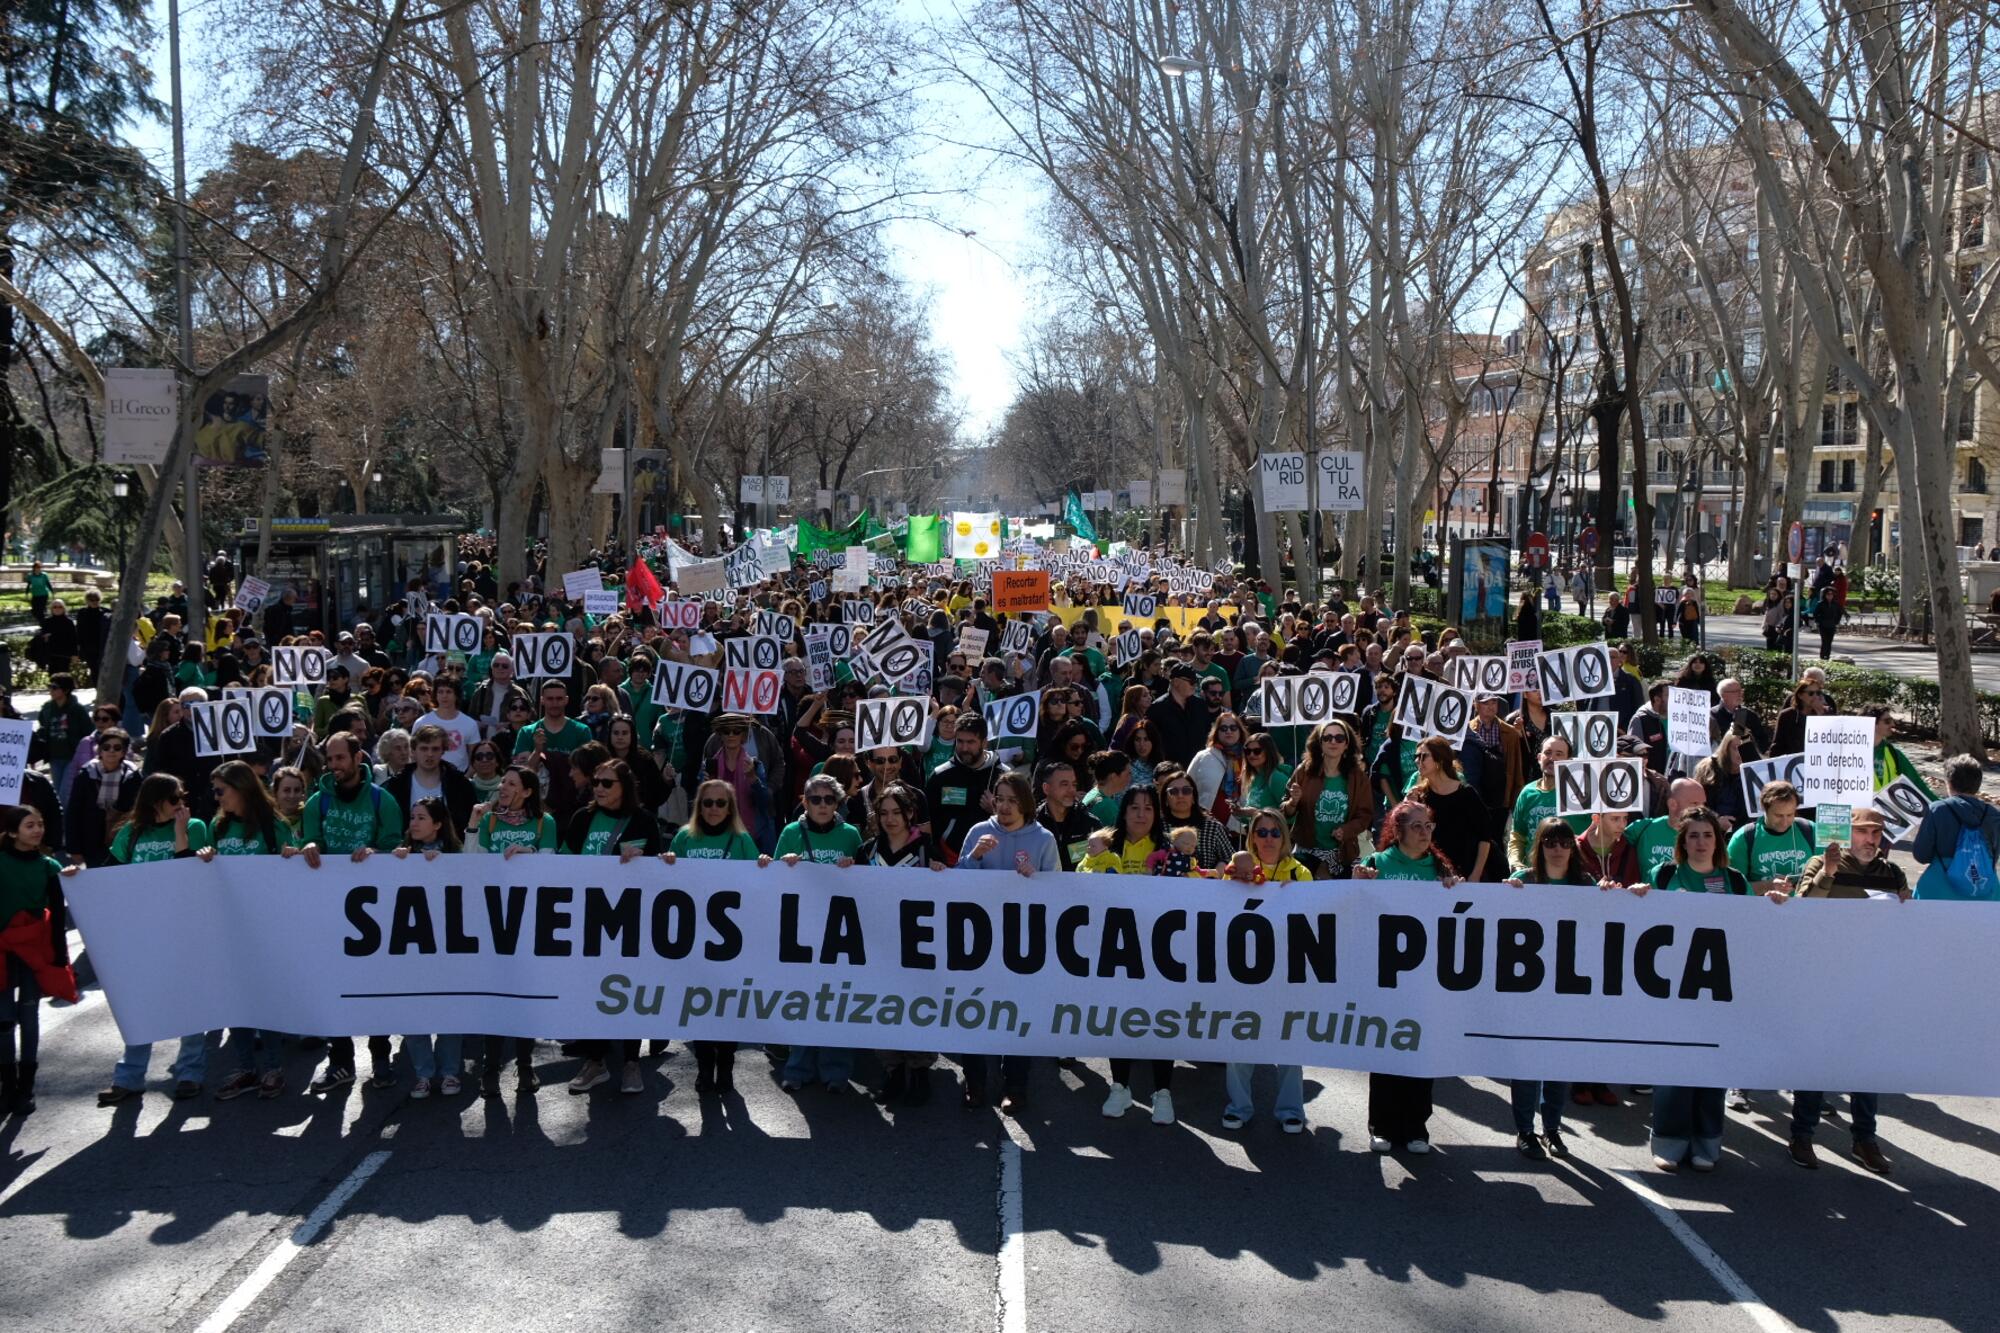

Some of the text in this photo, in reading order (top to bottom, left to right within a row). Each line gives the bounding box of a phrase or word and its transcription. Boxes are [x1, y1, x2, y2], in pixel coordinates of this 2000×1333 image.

[111, 400, 170, 415] El Greco
[1263, 457, 1303, 471] MAD
[1321, 457, 1354, 470] CUL
[1280, 471, 1304, 484] RID
[1327, 471, 1348, 484] TU
[1339, 486, 1360, 499] RA
[831, 554, 845, 565] NO
[877, 559, 894, 571] NO
[1070, 549, 1090, 563] NO
[1129, 551, 1147, 566] NO
[1156, 558, 1172, 571] NO
[926, 564, 944, 576] NO
[1087, 566, 1107, 580] NO
[1123, 563, 1141, 576] NO
[1217, 560, 1232, 574] NO
[1004, 577, 1037, 592] ¡Recortar
[1191, 570, 1212, 588] NO
[810, 581, 825, 598] NO
[1655, 589, 1676, 604] NO
[905, 599, 928, 616] NO
[997, 597, 1006, 607] es
[1124, 597, 1154, 616] NO
[663, 603, 698, 627] NO
[844, 602, 873, 622] NO
[428, 617, 479, 652] NO
[757, 611, 793, 640] NO
[1001, 621, 1028, 650] NO
[516, 635, 572, 677] NO
[727, 637, 779, 669] NO
[863, 620, 919, 677] NO
[1117, 631, 1139, 666] NO
[275, 649, 325, 682] NO
[1537, 646, 1609, 699] NO
[1456, 659, 1507, 691] NO
[653, 664, 714, 708] NO
[724, 670, 779, 712] NO
[1265, 677, 1329, 723] NO
[1398, 677, 1467, 735] NO
[1674, 691, 1681, 703] La
[859, 700, 923, 747] NO
[985, 697, 1040, 739] NO
[1672, 712, 1679, 721] es
[1680, 711, 1687, 722] de
[192, 702, 250, 753] NO
[1553, 714, 1614, 758] NO
[1671, 730, 1675, 743] y
[1676, 731, 1688, 743] para
[1808, 730, 1869, 748] La educación,
[1810, 752, 1866, 770] un derecho,
[1559, 761, 1639, 812] NO
[1806, 777, 1869, 794] no negocio!
[1874, 782, 1930, 840] NO
[344, 886, 1732, 1002] SALVEMOS LA EDUCACIÓN PÚBLICA
[596, 973, 1421, 1051] Su privatización, nuestra ruina
